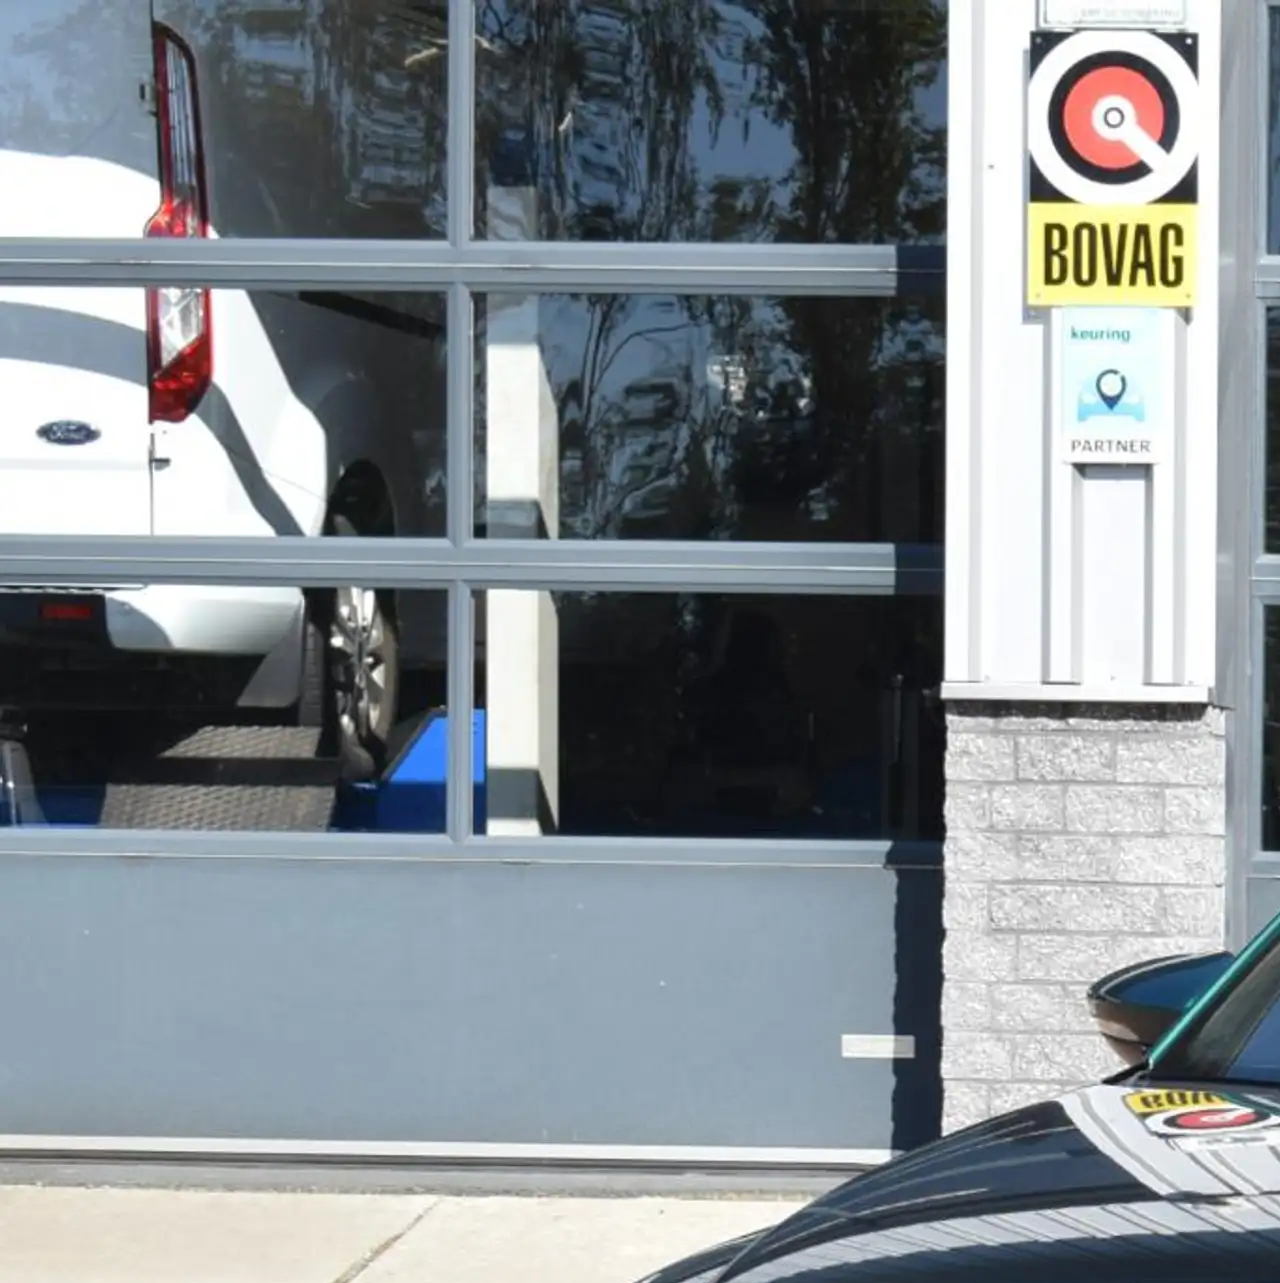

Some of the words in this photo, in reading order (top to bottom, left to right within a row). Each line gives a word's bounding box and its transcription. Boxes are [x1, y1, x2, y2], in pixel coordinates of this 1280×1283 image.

[1043, 222, 1184, 288] BOVAG
[1070, 326, 1131, 344] keuring
[1070, 439, 1151, 454] PARTNER
